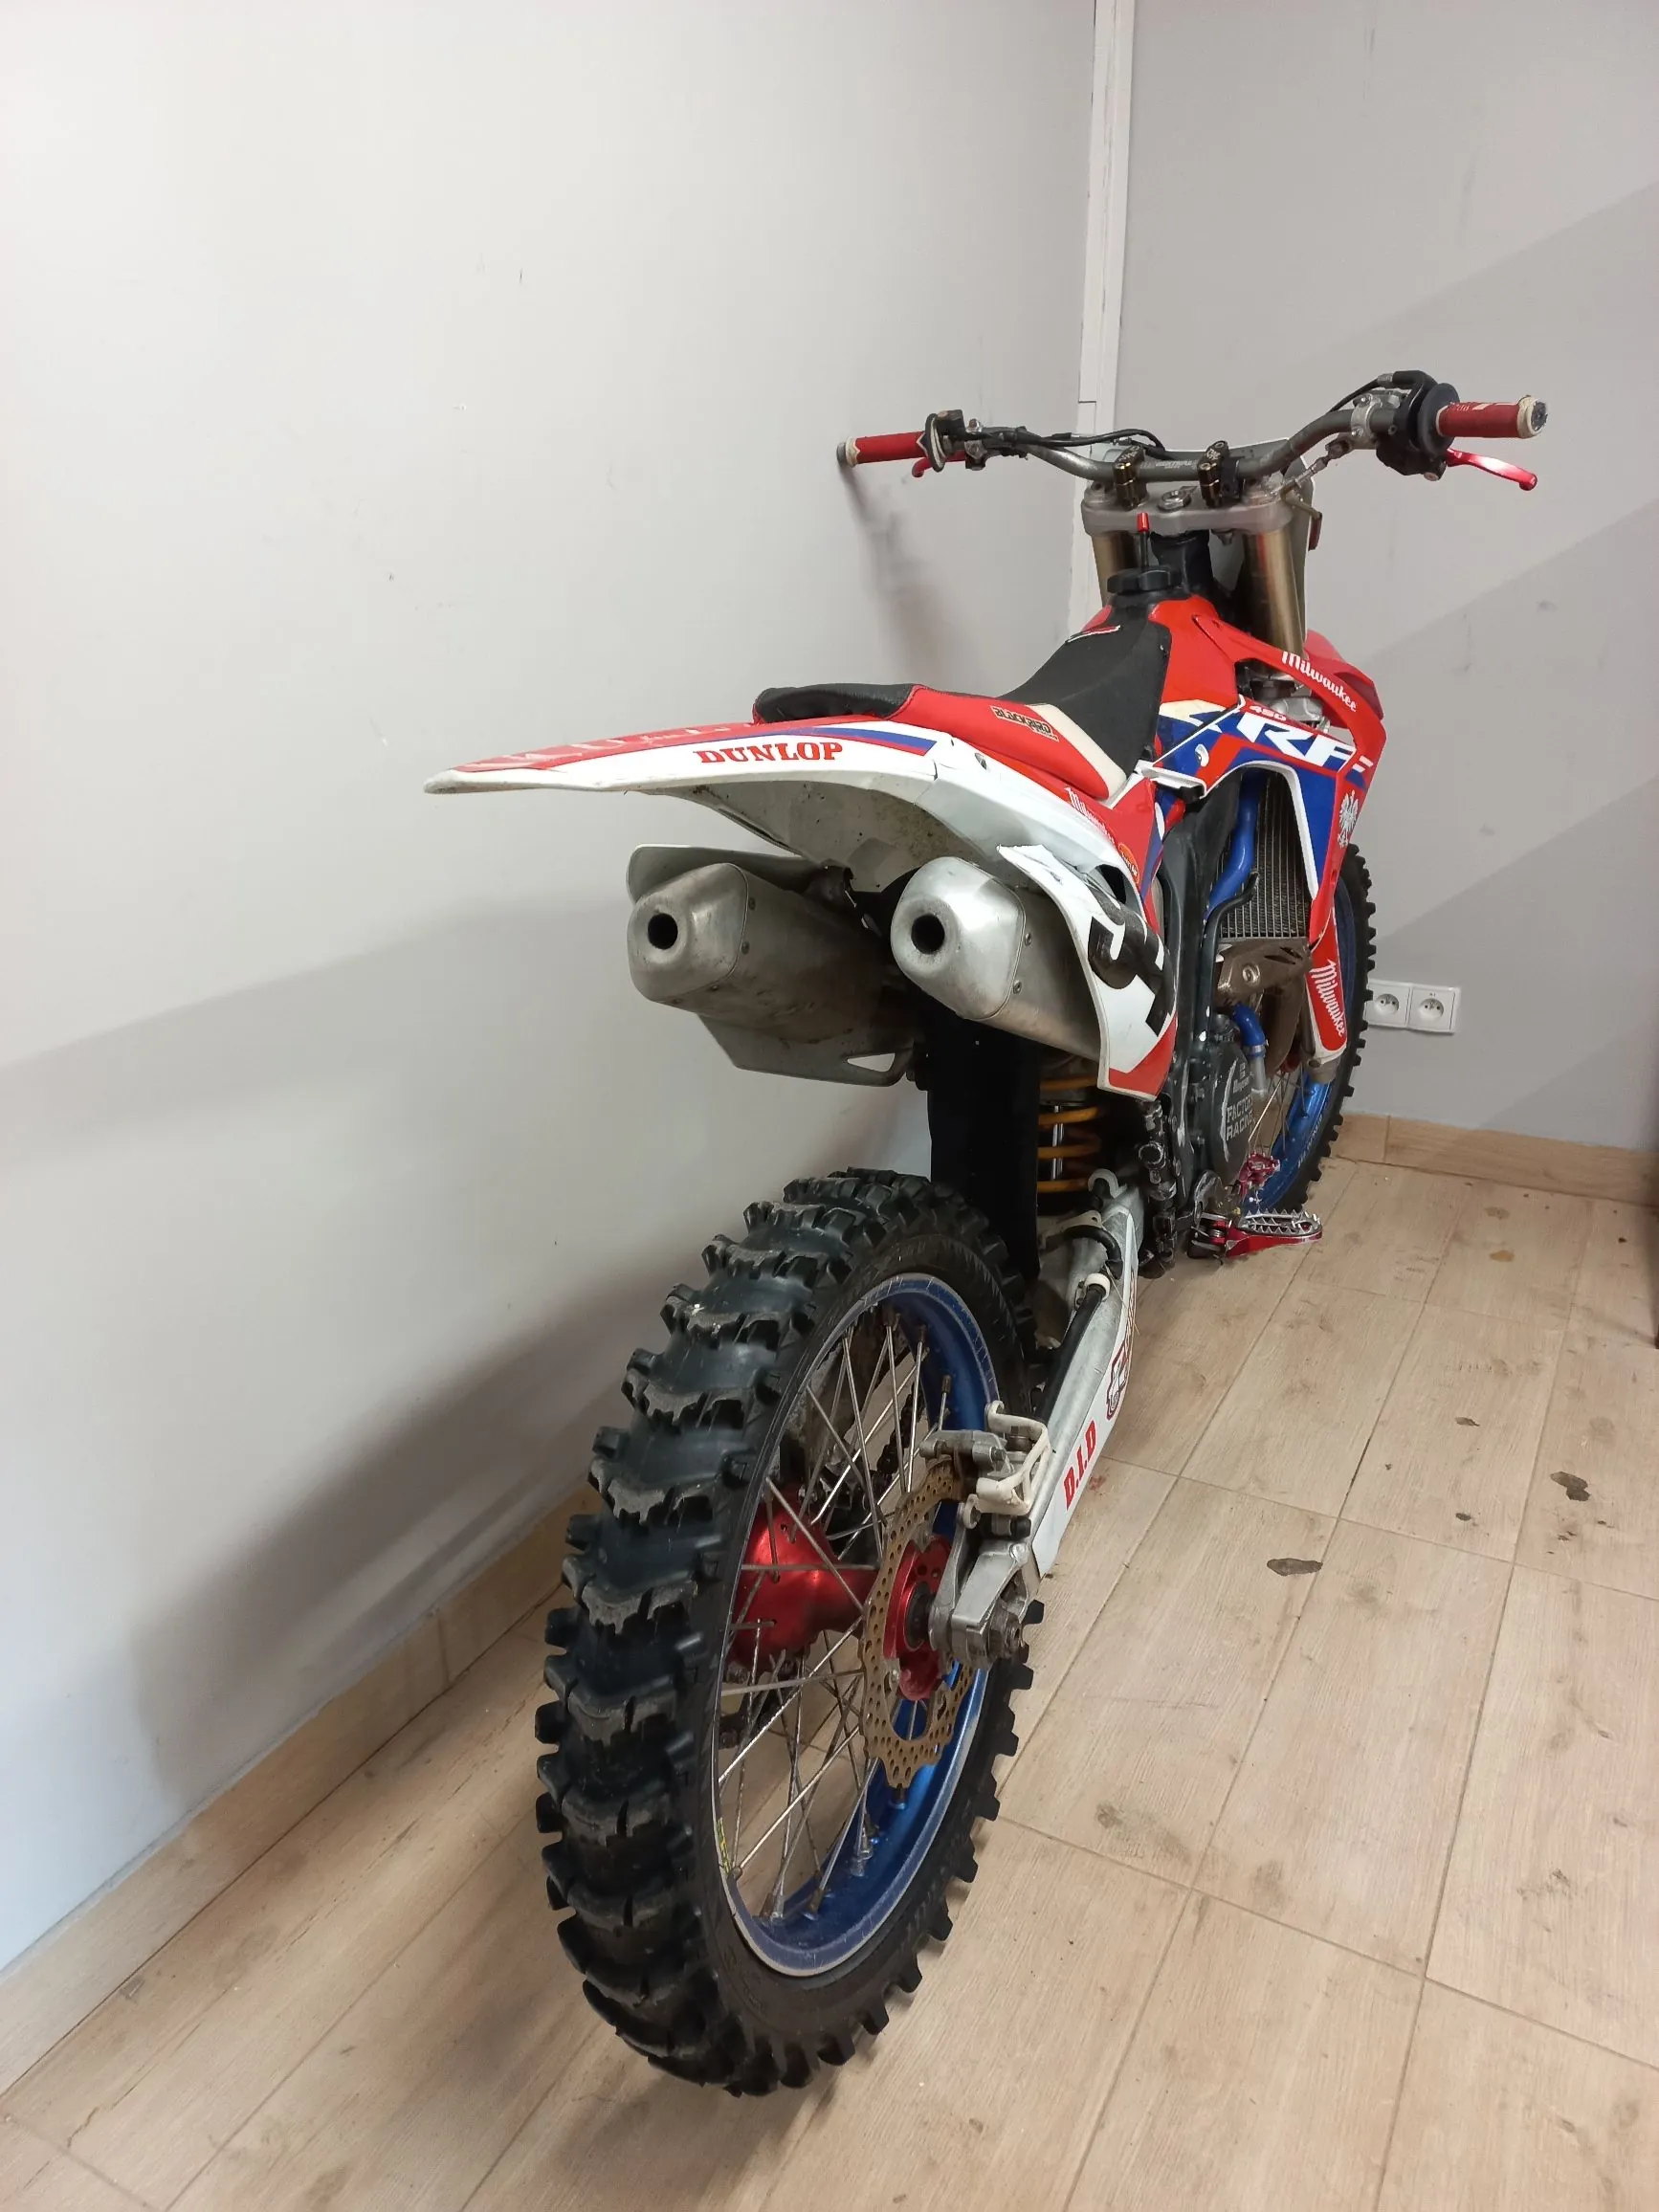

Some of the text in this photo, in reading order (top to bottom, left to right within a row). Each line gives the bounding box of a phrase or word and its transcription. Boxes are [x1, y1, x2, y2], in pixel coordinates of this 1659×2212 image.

[1281, 651, 1358, 713] Milwaukee
[692, 741, 843, 763] DUNLOP
[1309, 958, 1345, 1038] Milwaukee
[1063, 1420, 1097, 1512] D.I.D
